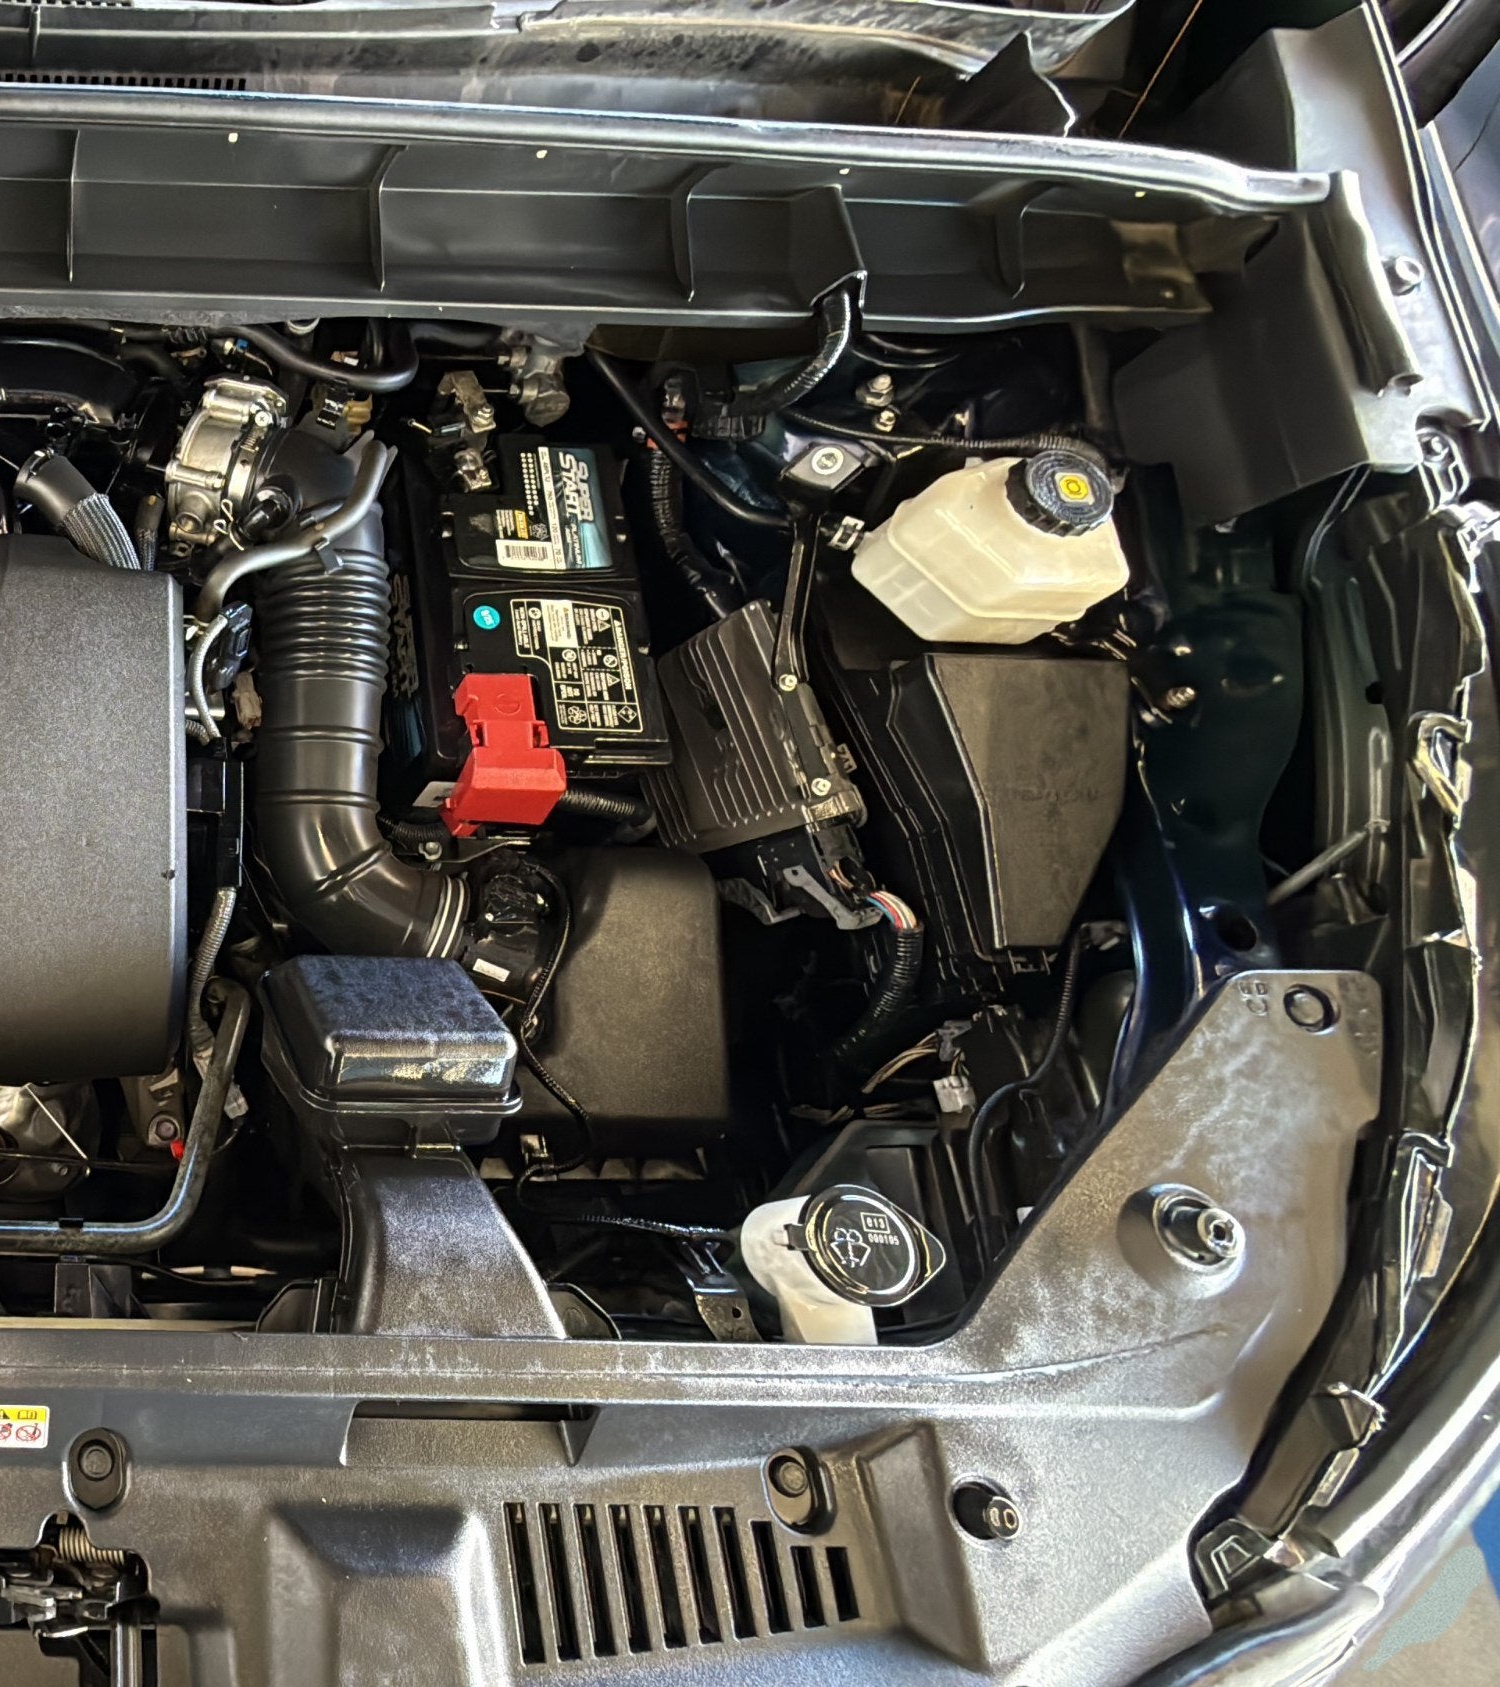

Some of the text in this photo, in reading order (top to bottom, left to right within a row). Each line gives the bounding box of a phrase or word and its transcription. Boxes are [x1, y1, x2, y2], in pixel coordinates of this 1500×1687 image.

[558, 451, 581, 521] START
[577, 461, 594, 522] SUPER
[570, 523, 583, 566] PLATINUM
